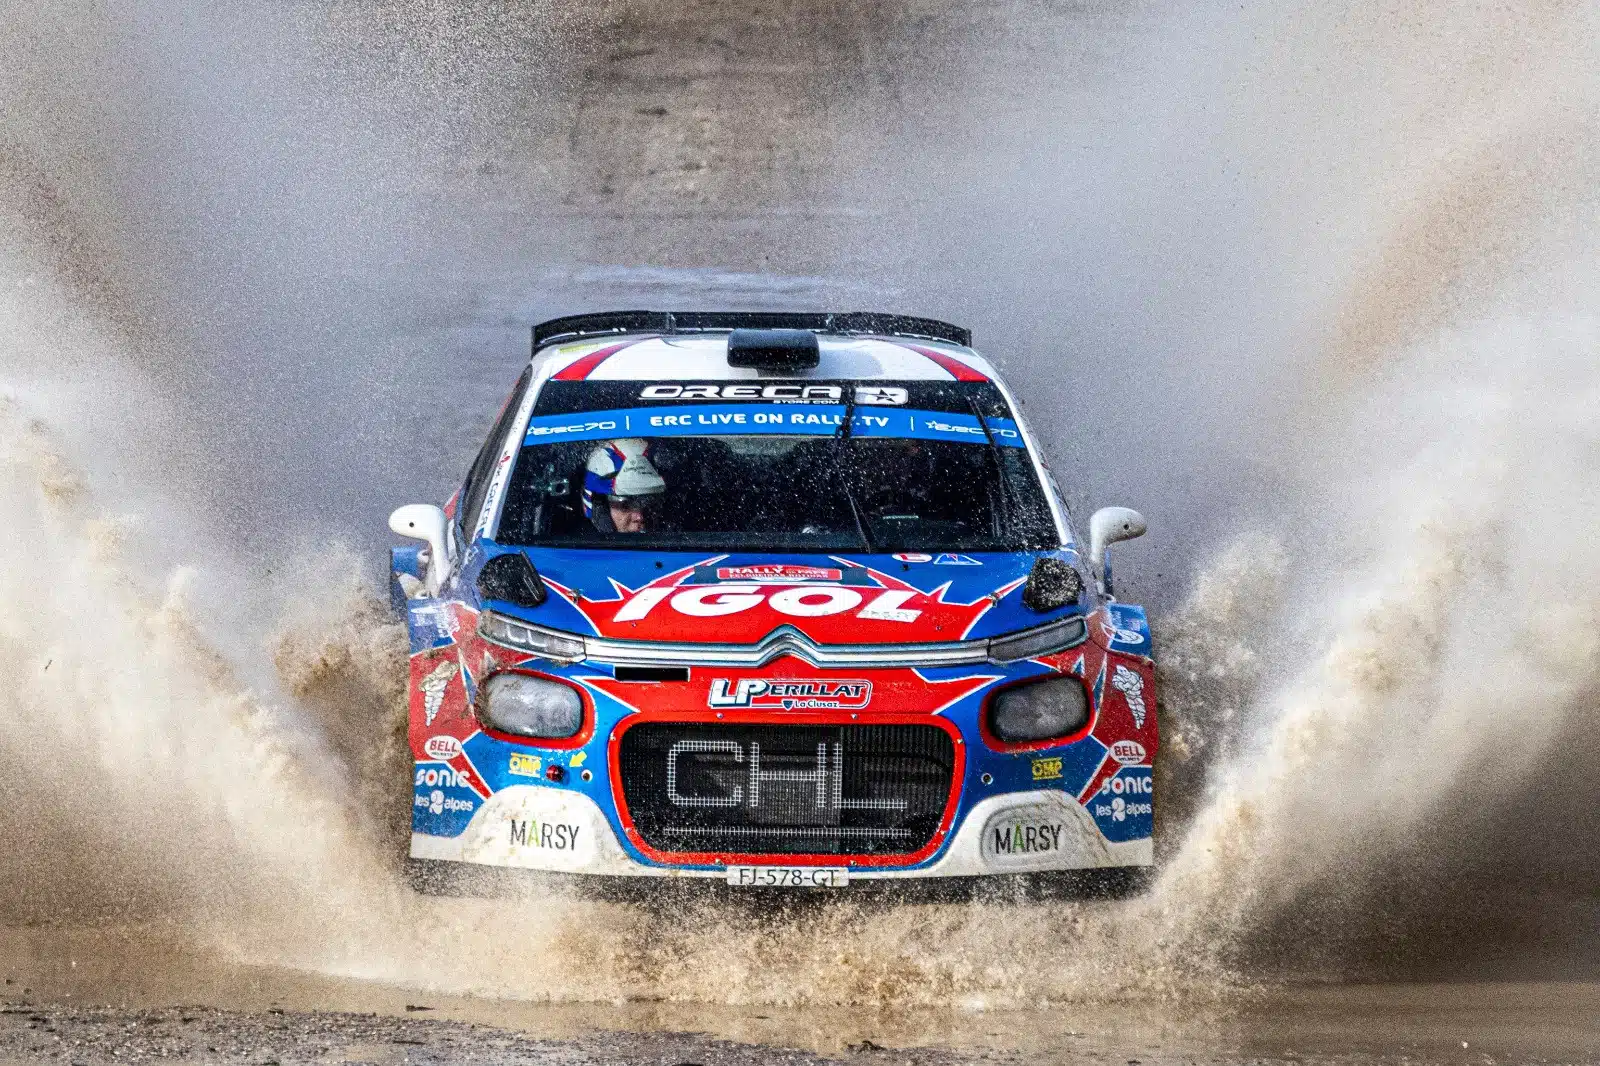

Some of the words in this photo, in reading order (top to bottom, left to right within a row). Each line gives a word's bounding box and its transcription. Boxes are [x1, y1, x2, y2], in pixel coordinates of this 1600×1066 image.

[639, 386, 842, 398] ORECA
[650, 415, 692, 426] ERC
[698, 414, 747, 424] LIVE
[753, 414, 784, 424] ON
[612, 586, 923, 622] IGOL
[808, 700, 838, 708] Clusaz
[430, 740, 457, 752] BELL
[1114, 746, 1144, 756] BELL
[415, 769, 470, 787] sonic
[1102, 776, 1153, 794] sonic
[414, 793, 429, 807] les
[429, 789, 444, 815] 2
[444, 797, 474, 813] alpes
[1096, 804, 1112, 817] les
[1112, 797, 1126, 822] 2
[1126, 802, 1152, 817] alpes
[509, 819, 580, 851] MARSY
[995, 823, 1062, 854] MARSY
[739, 868, 840, 886] FJ-578-GT
